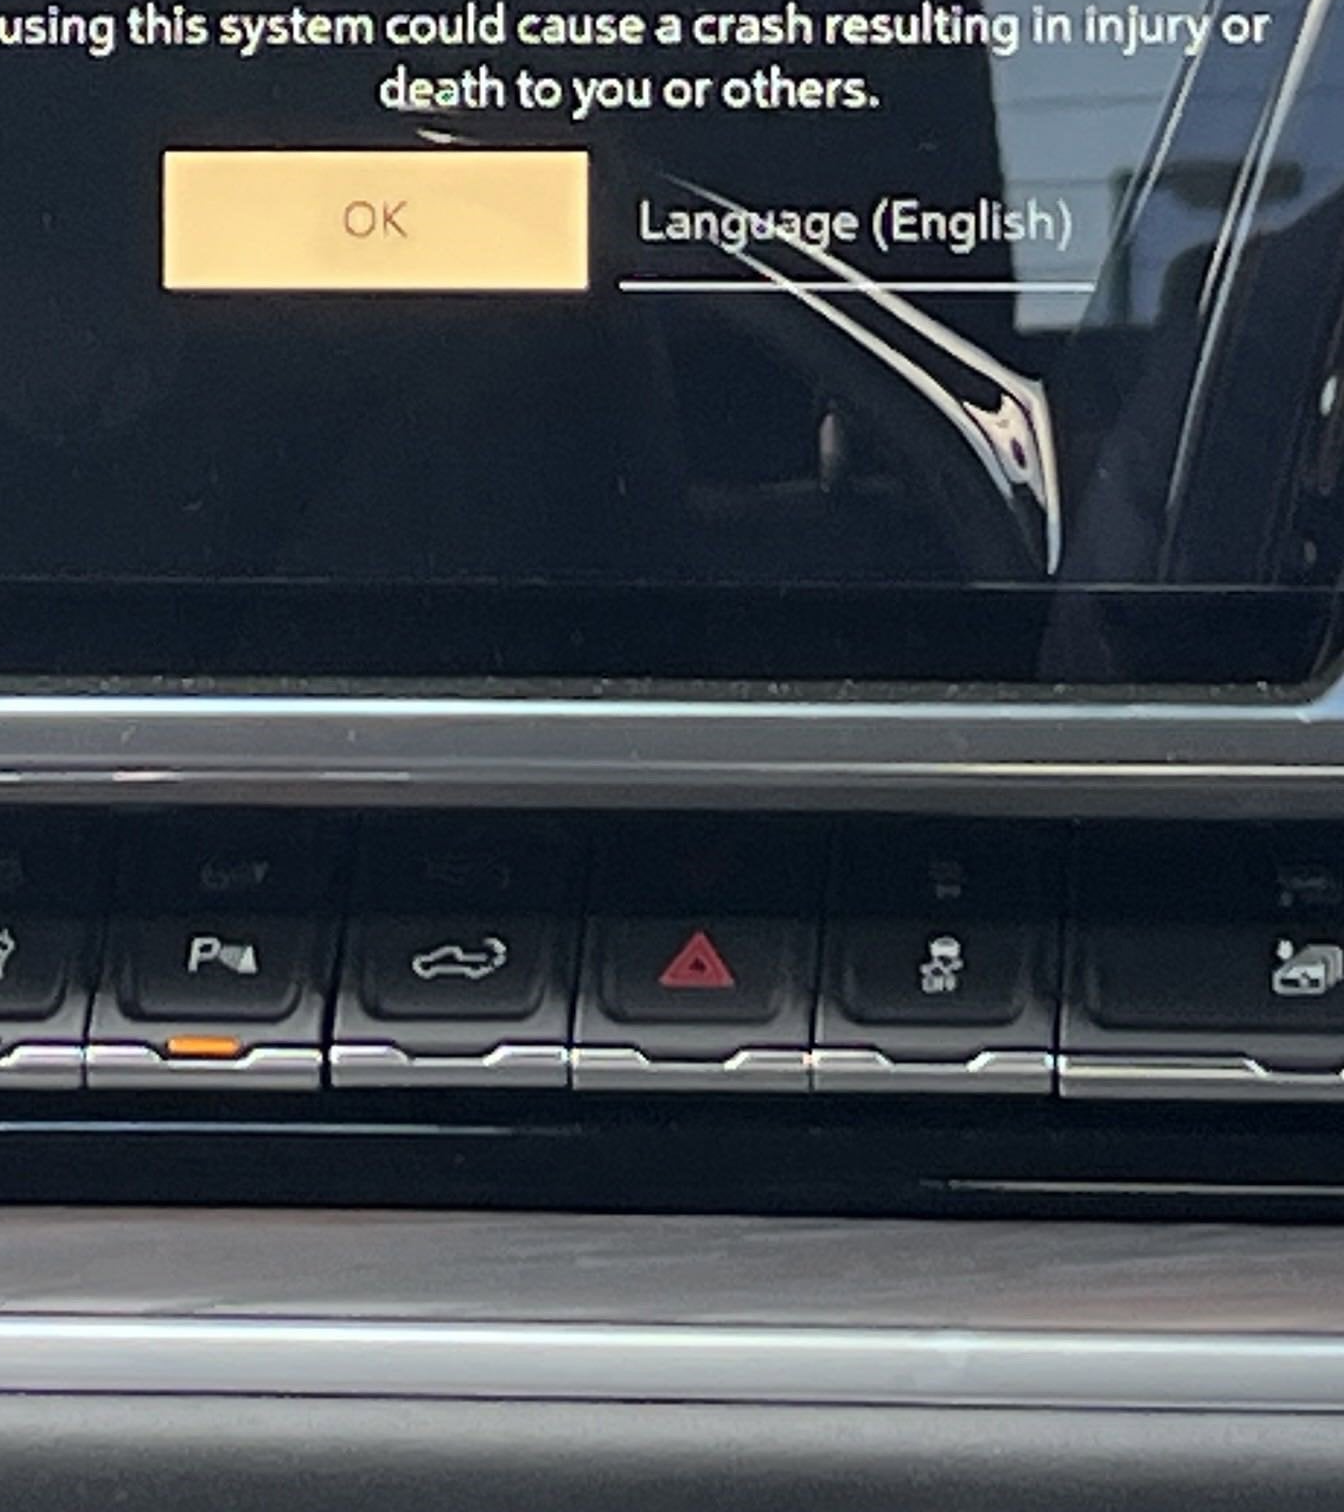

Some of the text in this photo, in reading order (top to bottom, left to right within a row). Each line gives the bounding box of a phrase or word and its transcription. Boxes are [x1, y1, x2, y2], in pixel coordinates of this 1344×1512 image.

[126, 2, 210, 46] this
[218, 6, 376, 57] system
[385, 0, 508, 46] could
[516, 13, 646, 46] cause
[654, 13, 683, 46] a
[692, 0, 814, 46] crash
[823, 0, 1020, 56] resulting
[1031, 3, 1073, 46] in
[1084, 2, 1209, 57] injury
[1220, 12, 1273, 46] or
[378, 63, 880, 120] death to you or others.
[342, 200, 410, 240] OK
[638, 196, 1074, 255] Language (English)
